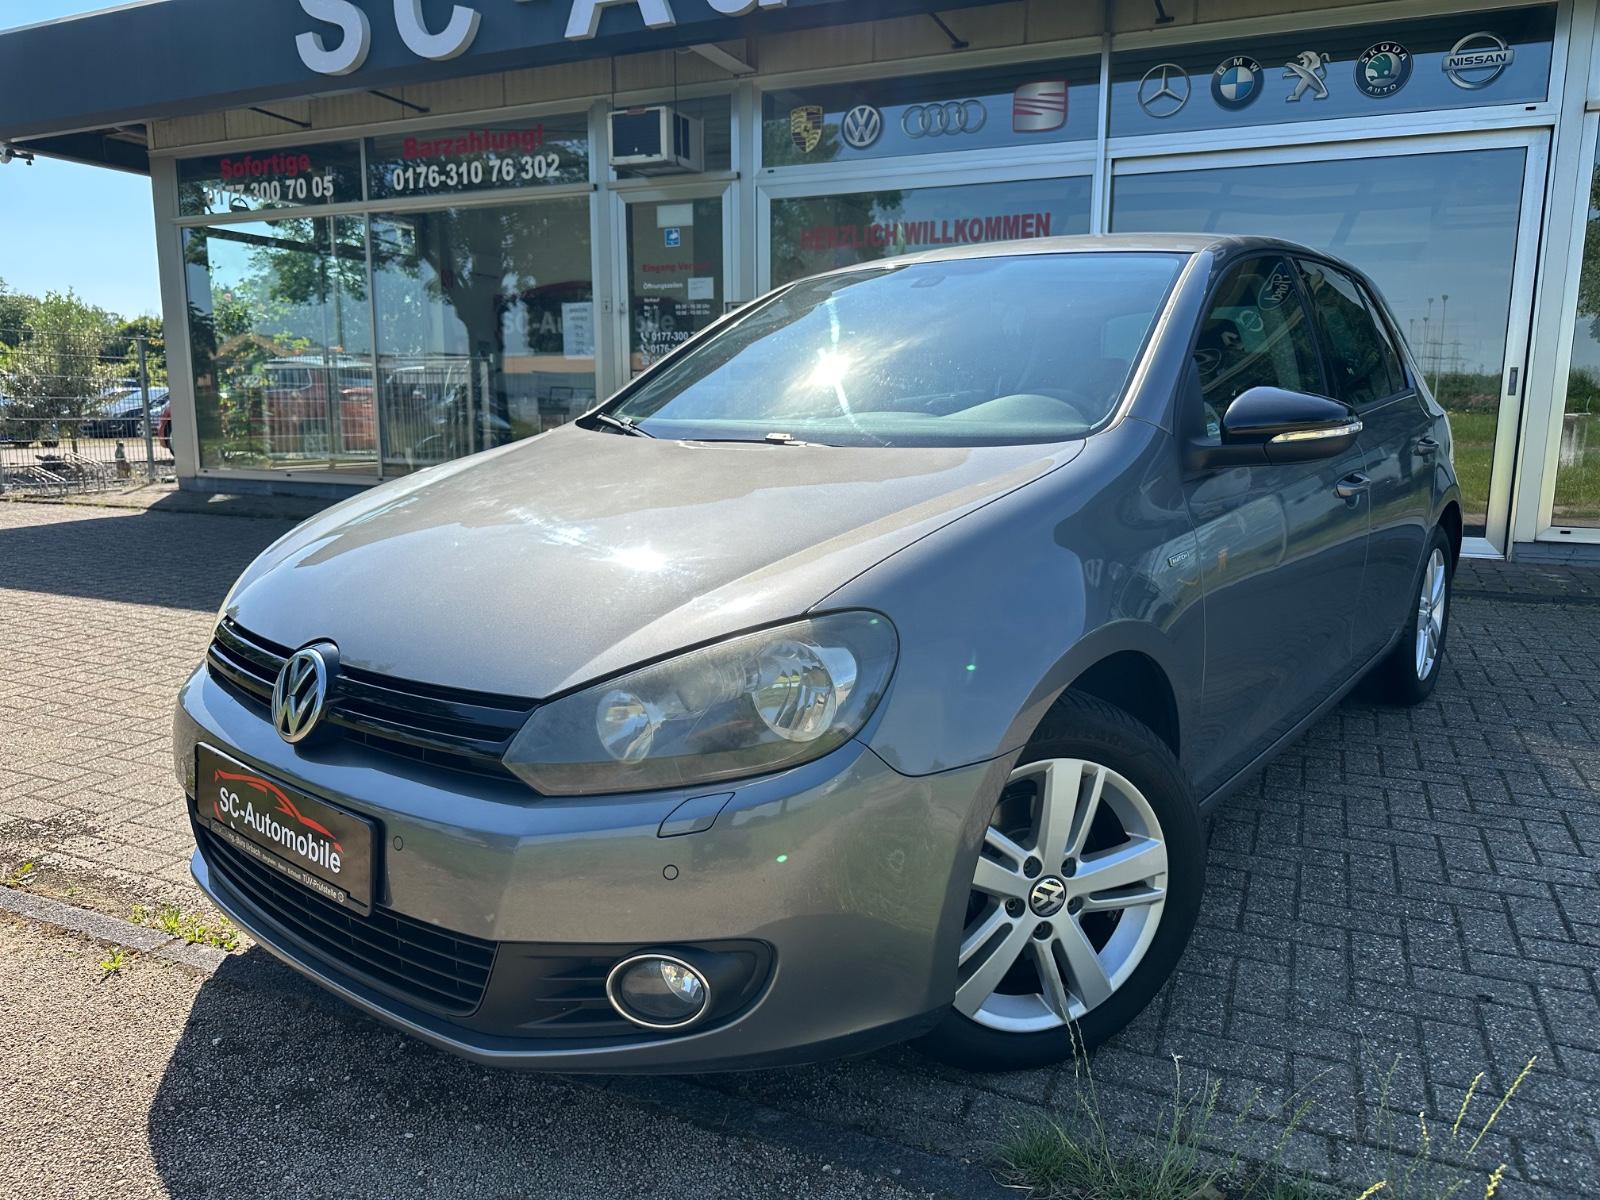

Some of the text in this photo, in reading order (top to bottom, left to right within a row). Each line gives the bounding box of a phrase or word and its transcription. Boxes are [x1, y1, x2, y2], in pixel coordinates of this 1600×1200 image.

[1217, 57, 1260, 76] BMW
[1361, 44, 1406, 65] SKODA
[1449, 53, 1507, 67] NISSAN
[1367, 83, 1397, 94] AUTO
[220, 124, 544, 179] Sofortige Barzahlung!
[393, 154, 560, 191] 0176-310 76 302
[285, 178, 307, 200] 70
[312, 175, 334, 198] 05
[904, 213, 1051, 245] WILLKOMMEN
[272, 648, 327, 743] VW
[219, 787, 342, 874] SC-Automobile
